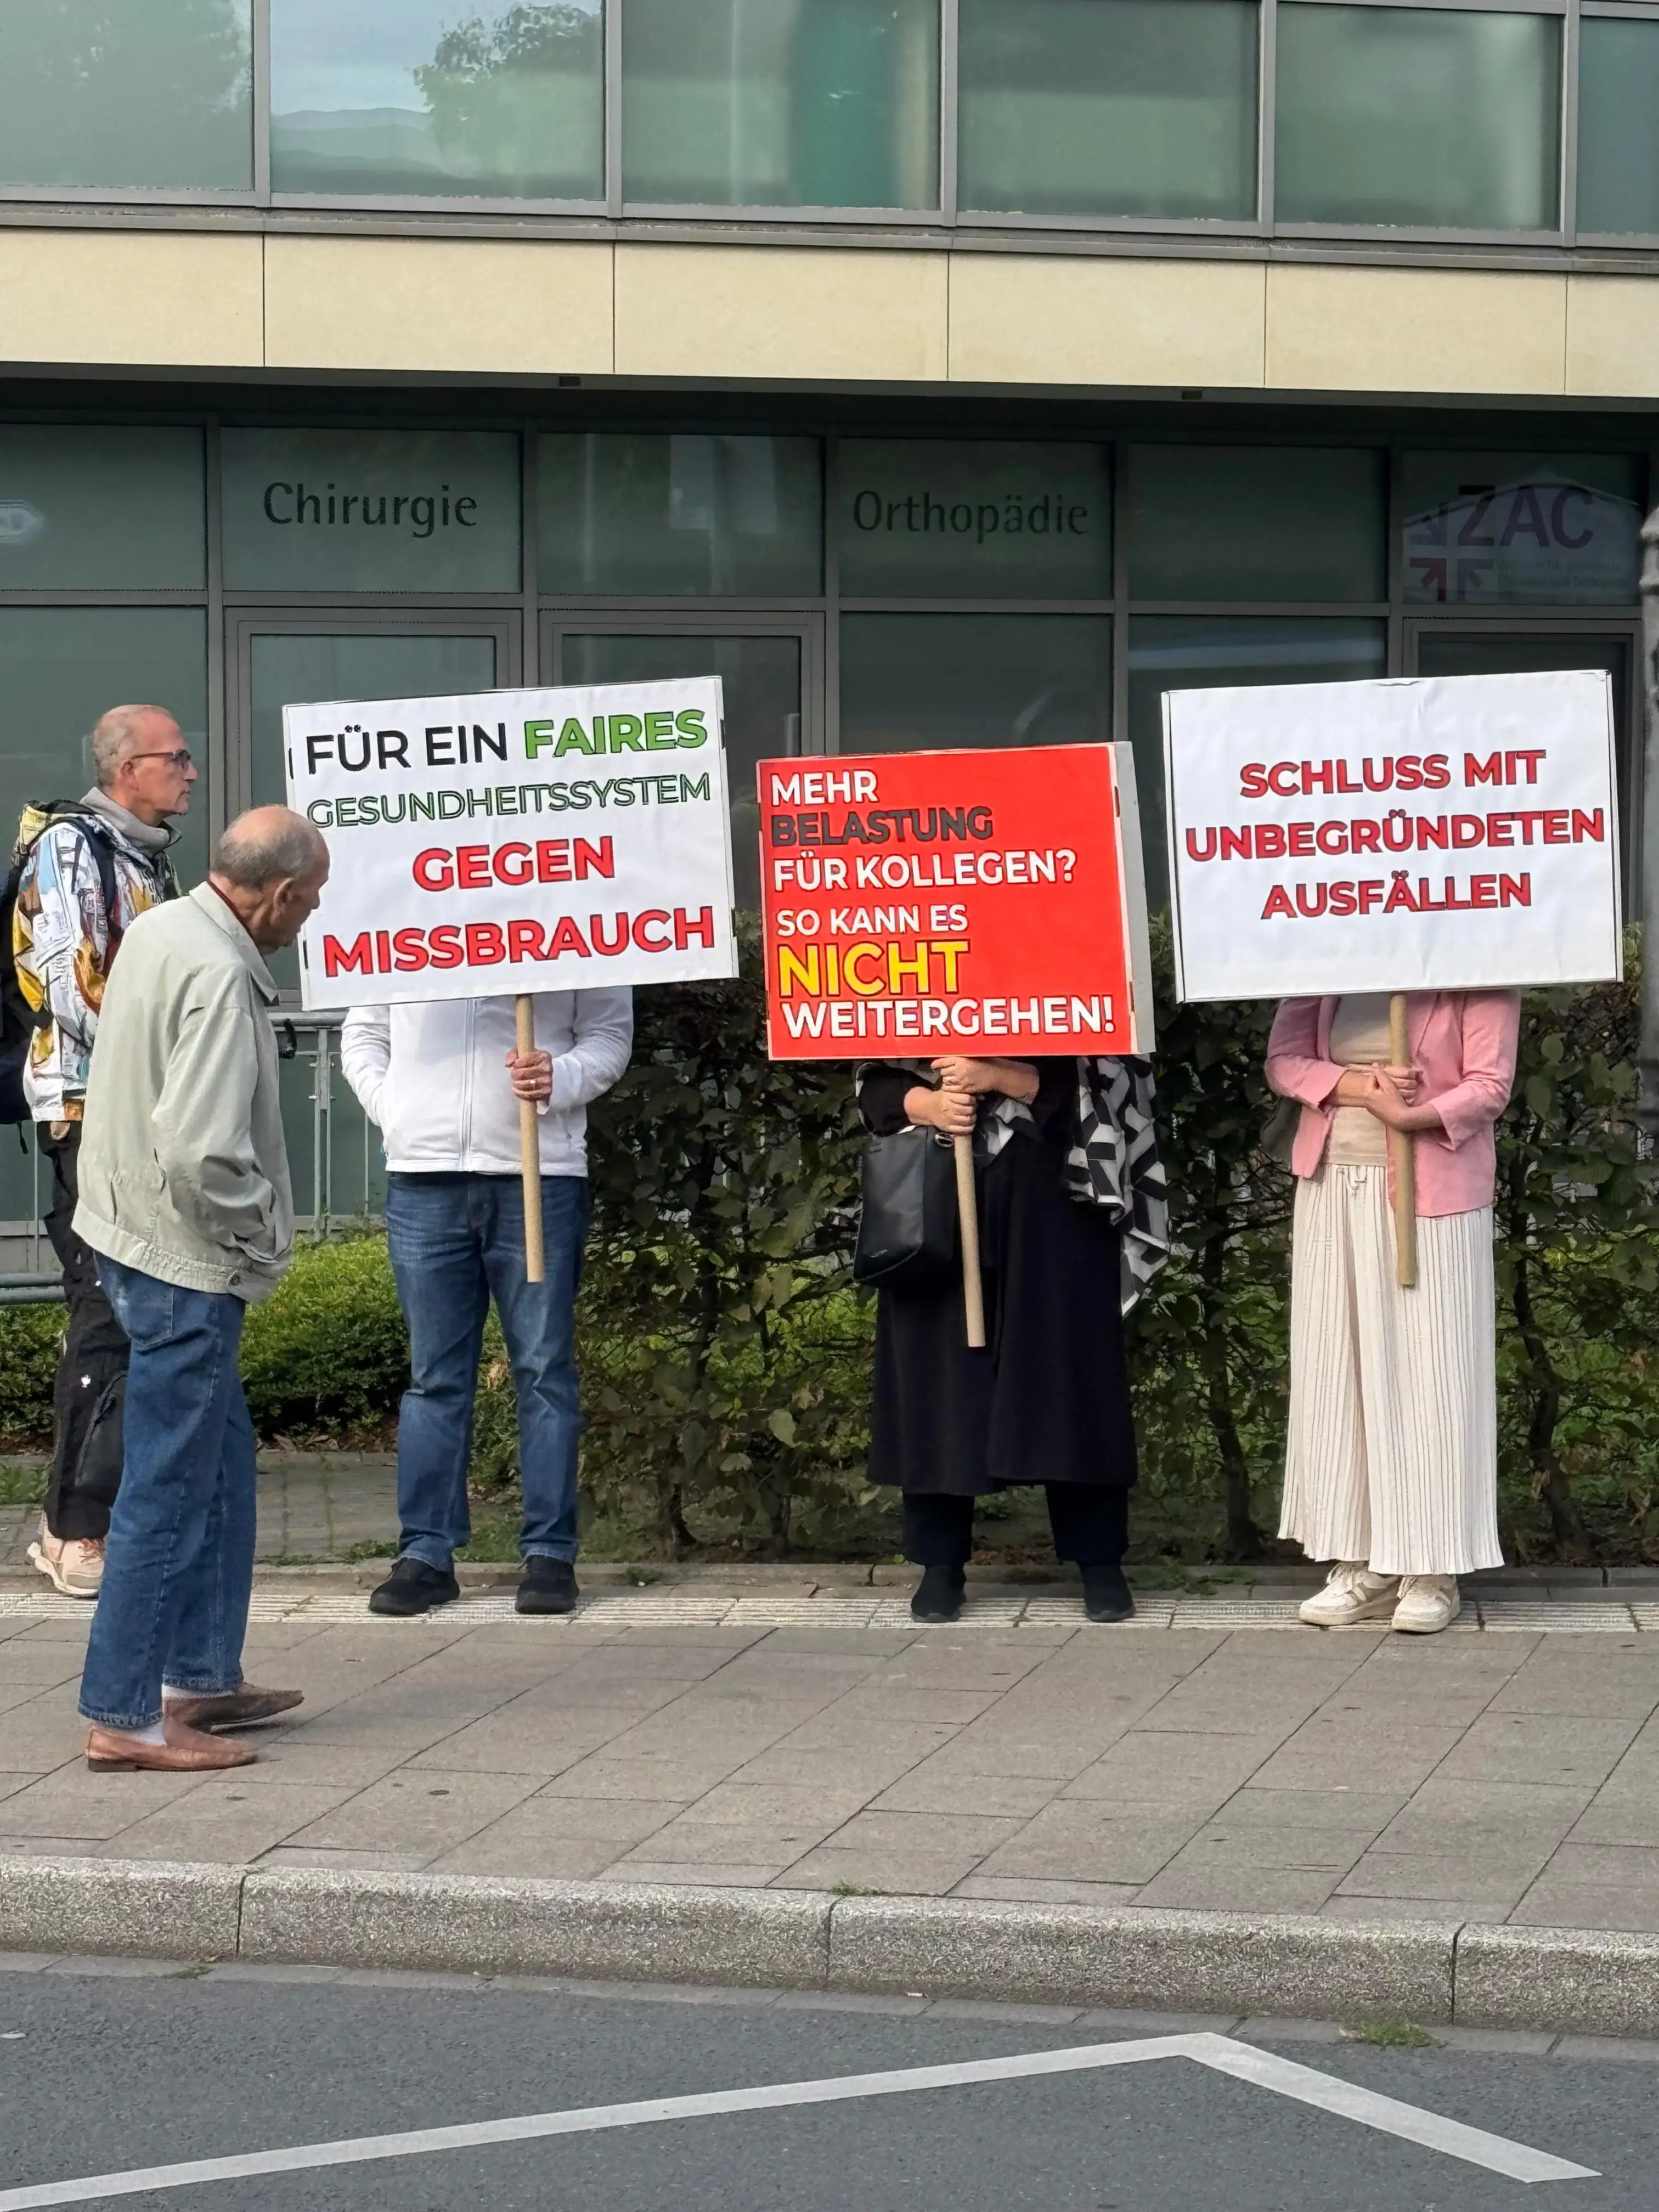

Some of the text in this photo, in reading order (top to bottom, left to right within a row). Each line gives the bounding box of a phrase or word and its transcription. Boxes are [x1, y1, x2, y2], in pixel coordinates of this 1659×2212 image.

[263, 481, 478, 538] Chirurgie
[853, 490, 1088, 544] Orthopädie
[1458, 485, 1594, 549] ZAC
[306, 709, 707, 775] FÜR EIN FAIRES
[307, 772, 710, 828] GESUNDHEITSSYSTEM
[770, 770, 879, 806] MEHR
[1240, 749, 1547, 798] SCHLUSS MIT
[771, 806, 993, 847] BELASTUNG
[1186, 808, 1604, 861] UNBEGRÜNDETEN
[413, 836, 615, 892] GEGEN
[774, 849, 1077, 892] FÜR KOLLEGEN?
[776, 905, 968, 936] SO KANN ES
[1261, 870, 1532, 920] AUSFÄLLEN
[323, 906, 715, 978] MISSBRAUCH
[778, 939, 969, 998] NICHT
[781, 995, 1115, 1039] WEITERGEHEN!
